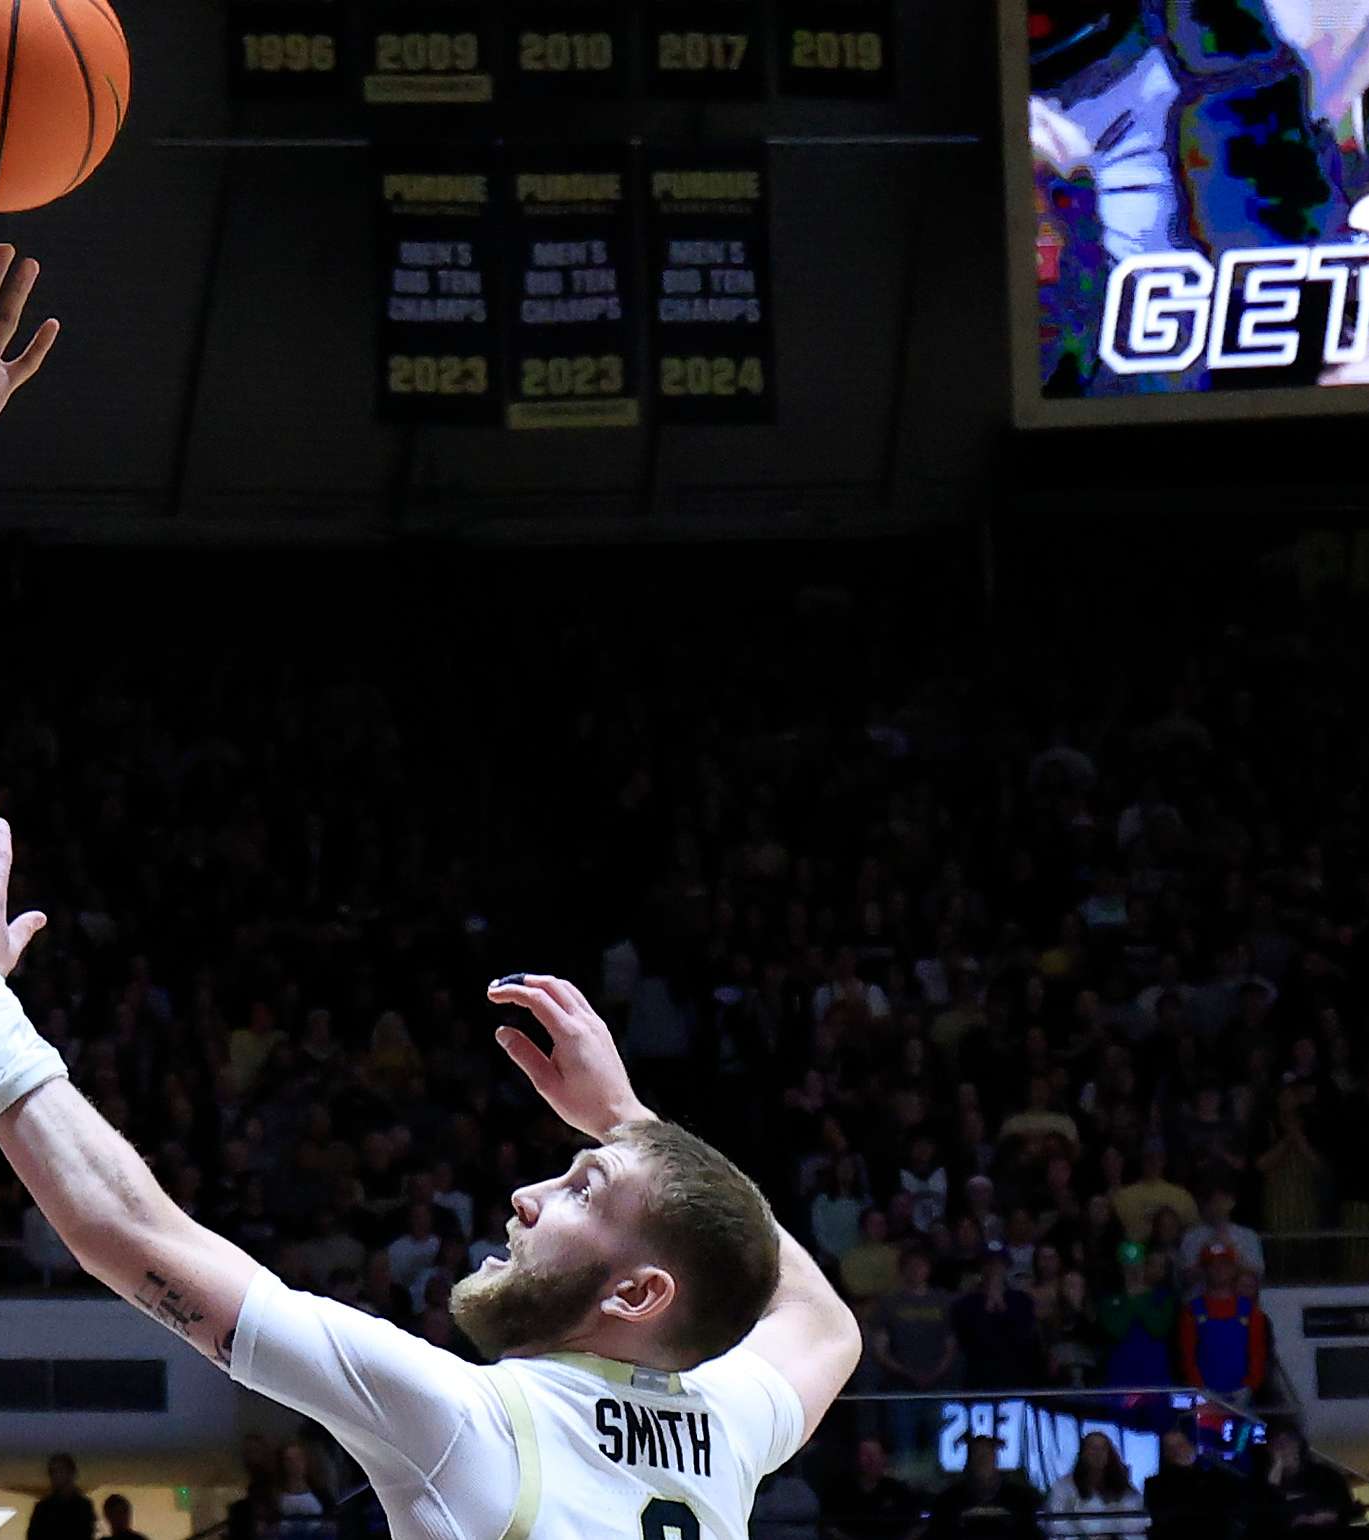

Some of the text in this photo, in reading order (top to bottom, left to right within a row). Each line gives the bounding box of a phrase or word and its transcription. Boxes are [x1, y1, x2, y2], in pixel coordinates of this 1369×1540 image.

[376, 33, 479, 71] 2009
[519, 32, 614, 71] 2010
[657, 32, 749, 70] 2017
[791, 29, 883, 71] 2019
[388, 354, 489, 396] 2023
[521, 355, 624, 397] 2023
[660, 355, 765, 397] 2024
[595, 1397, 712, 1478] SMITH
